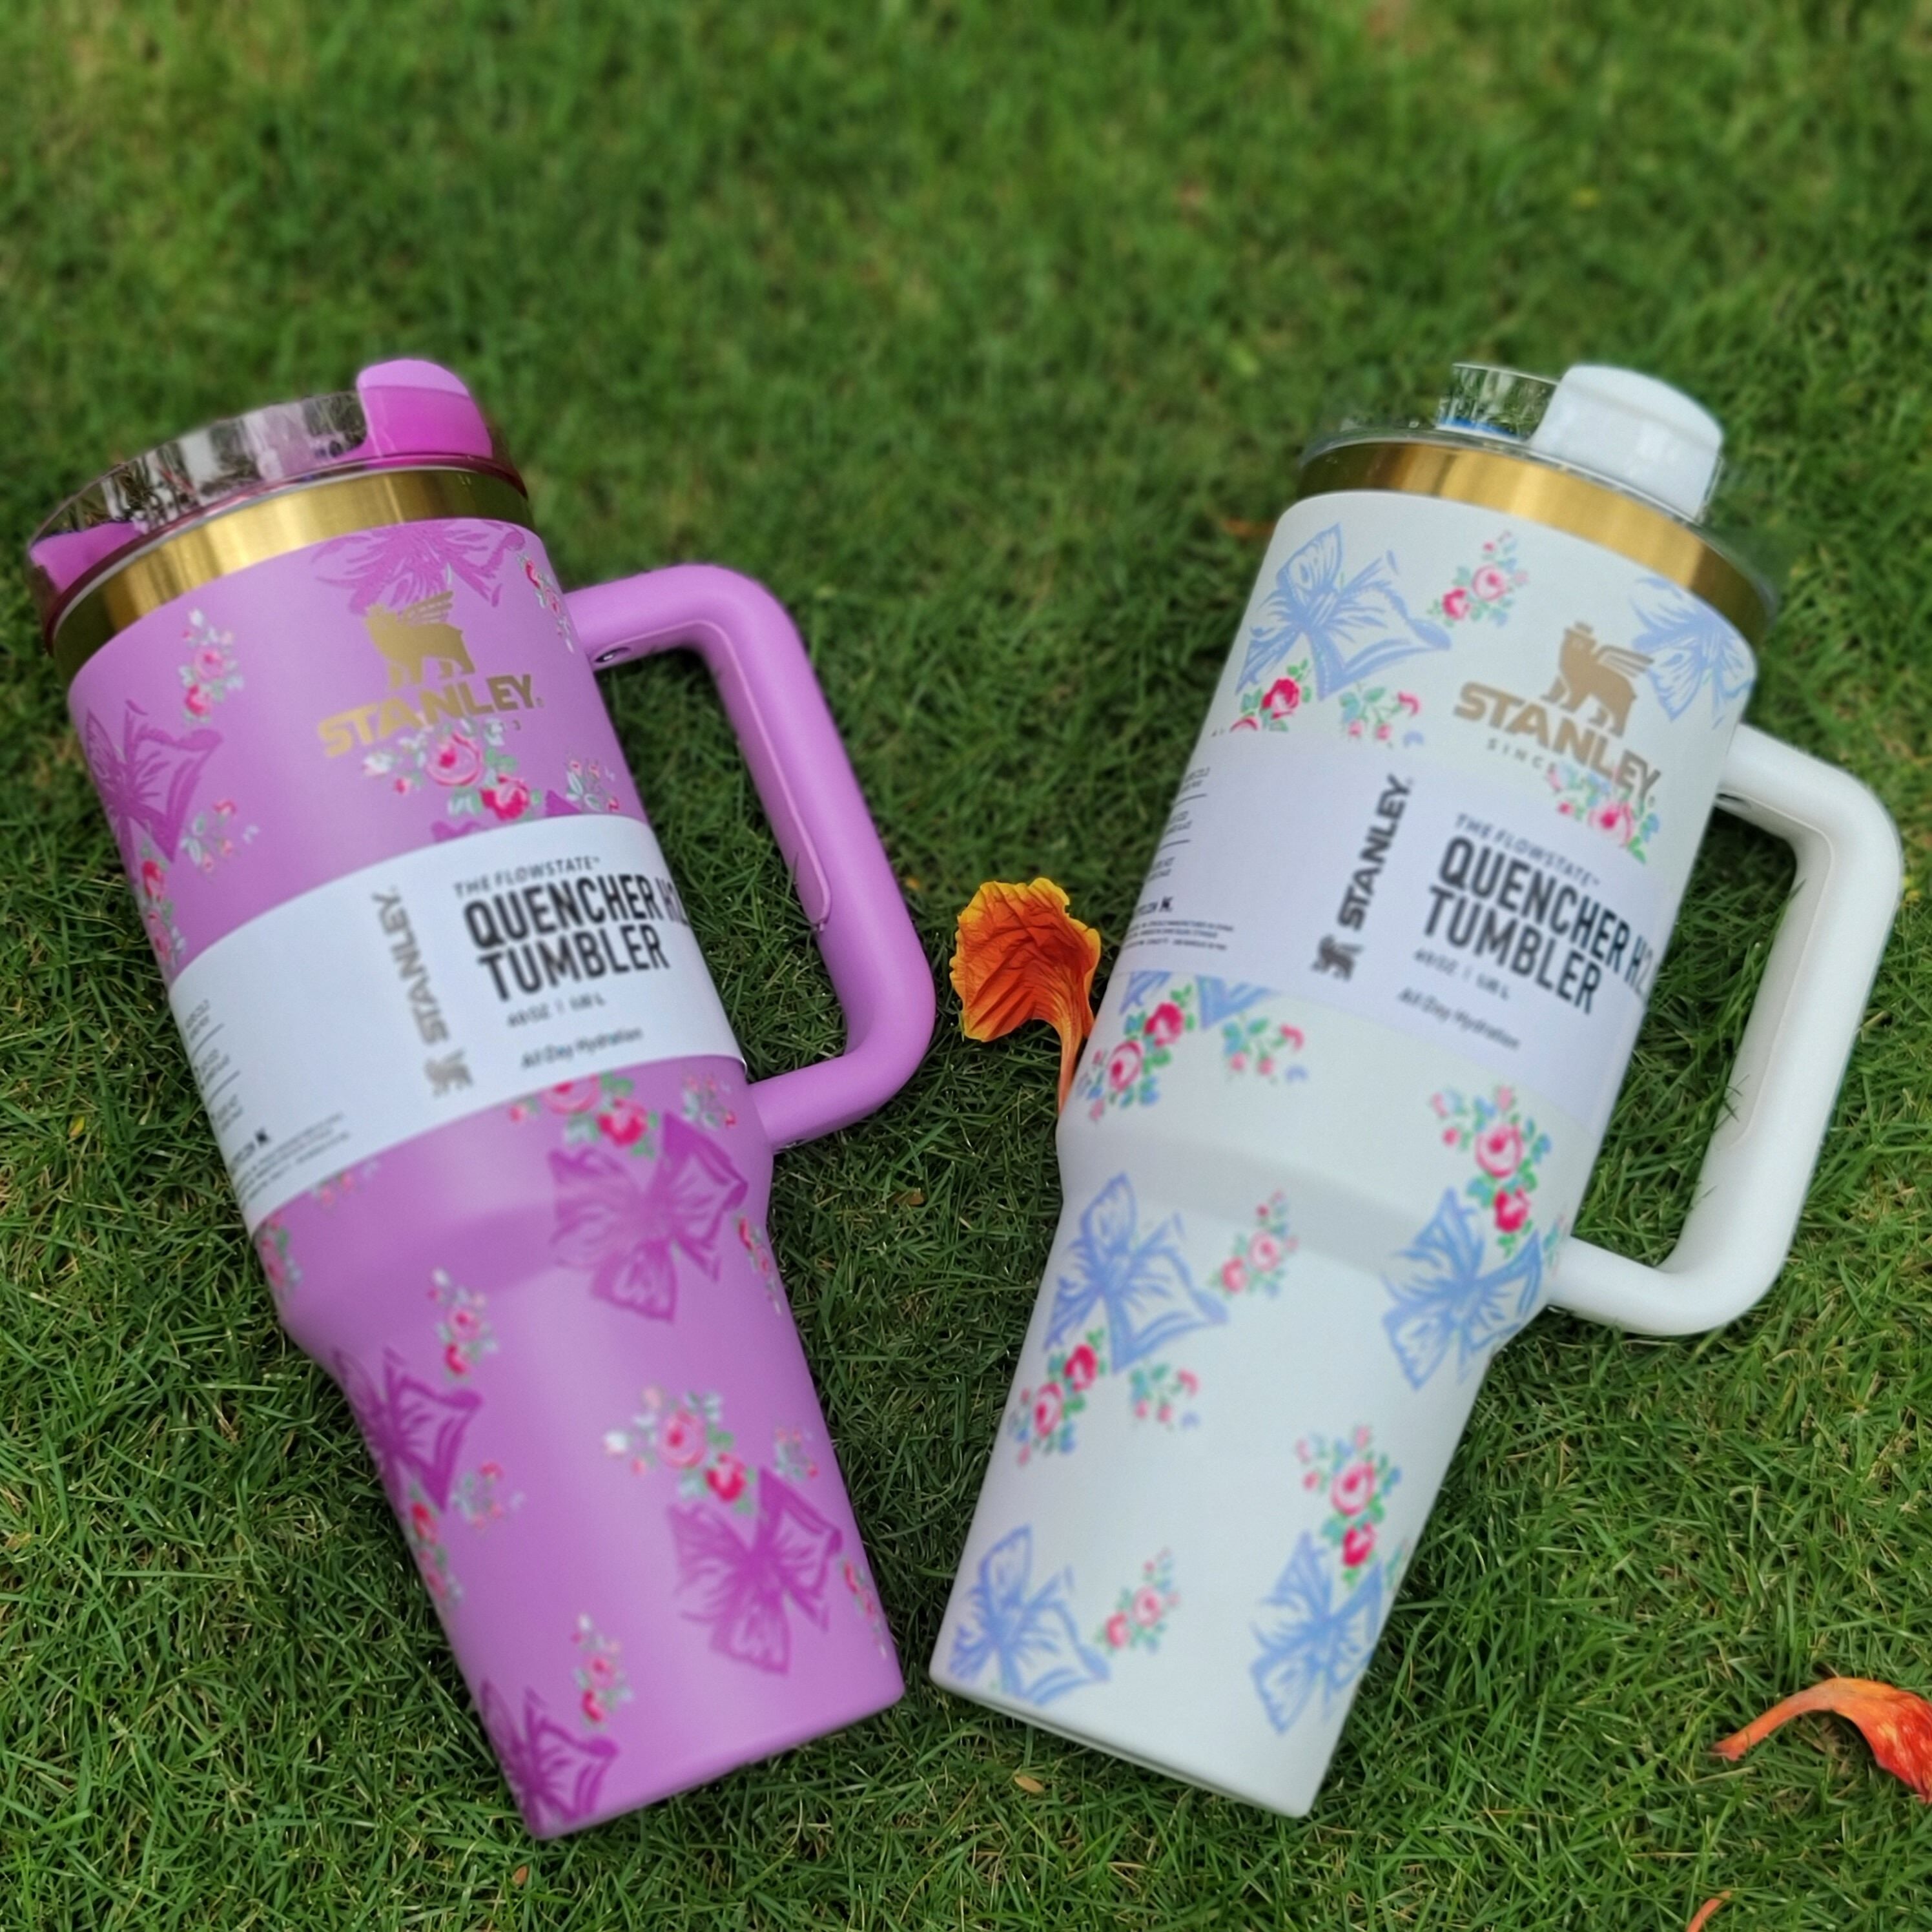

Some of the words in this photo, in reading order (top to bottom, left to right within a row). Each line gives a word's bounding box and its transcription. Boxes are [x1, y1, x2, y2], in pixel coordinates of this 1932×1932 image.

[463, 873, 664, 951] QUENCHER
[1337, 774, 1410, 931] STANLEY
[1438, 836, 1630, 974] QUENCHER
[477, 924, 670, 1002] TUMBLER
[1424, 885, 1601, 1016] TUMBLER
